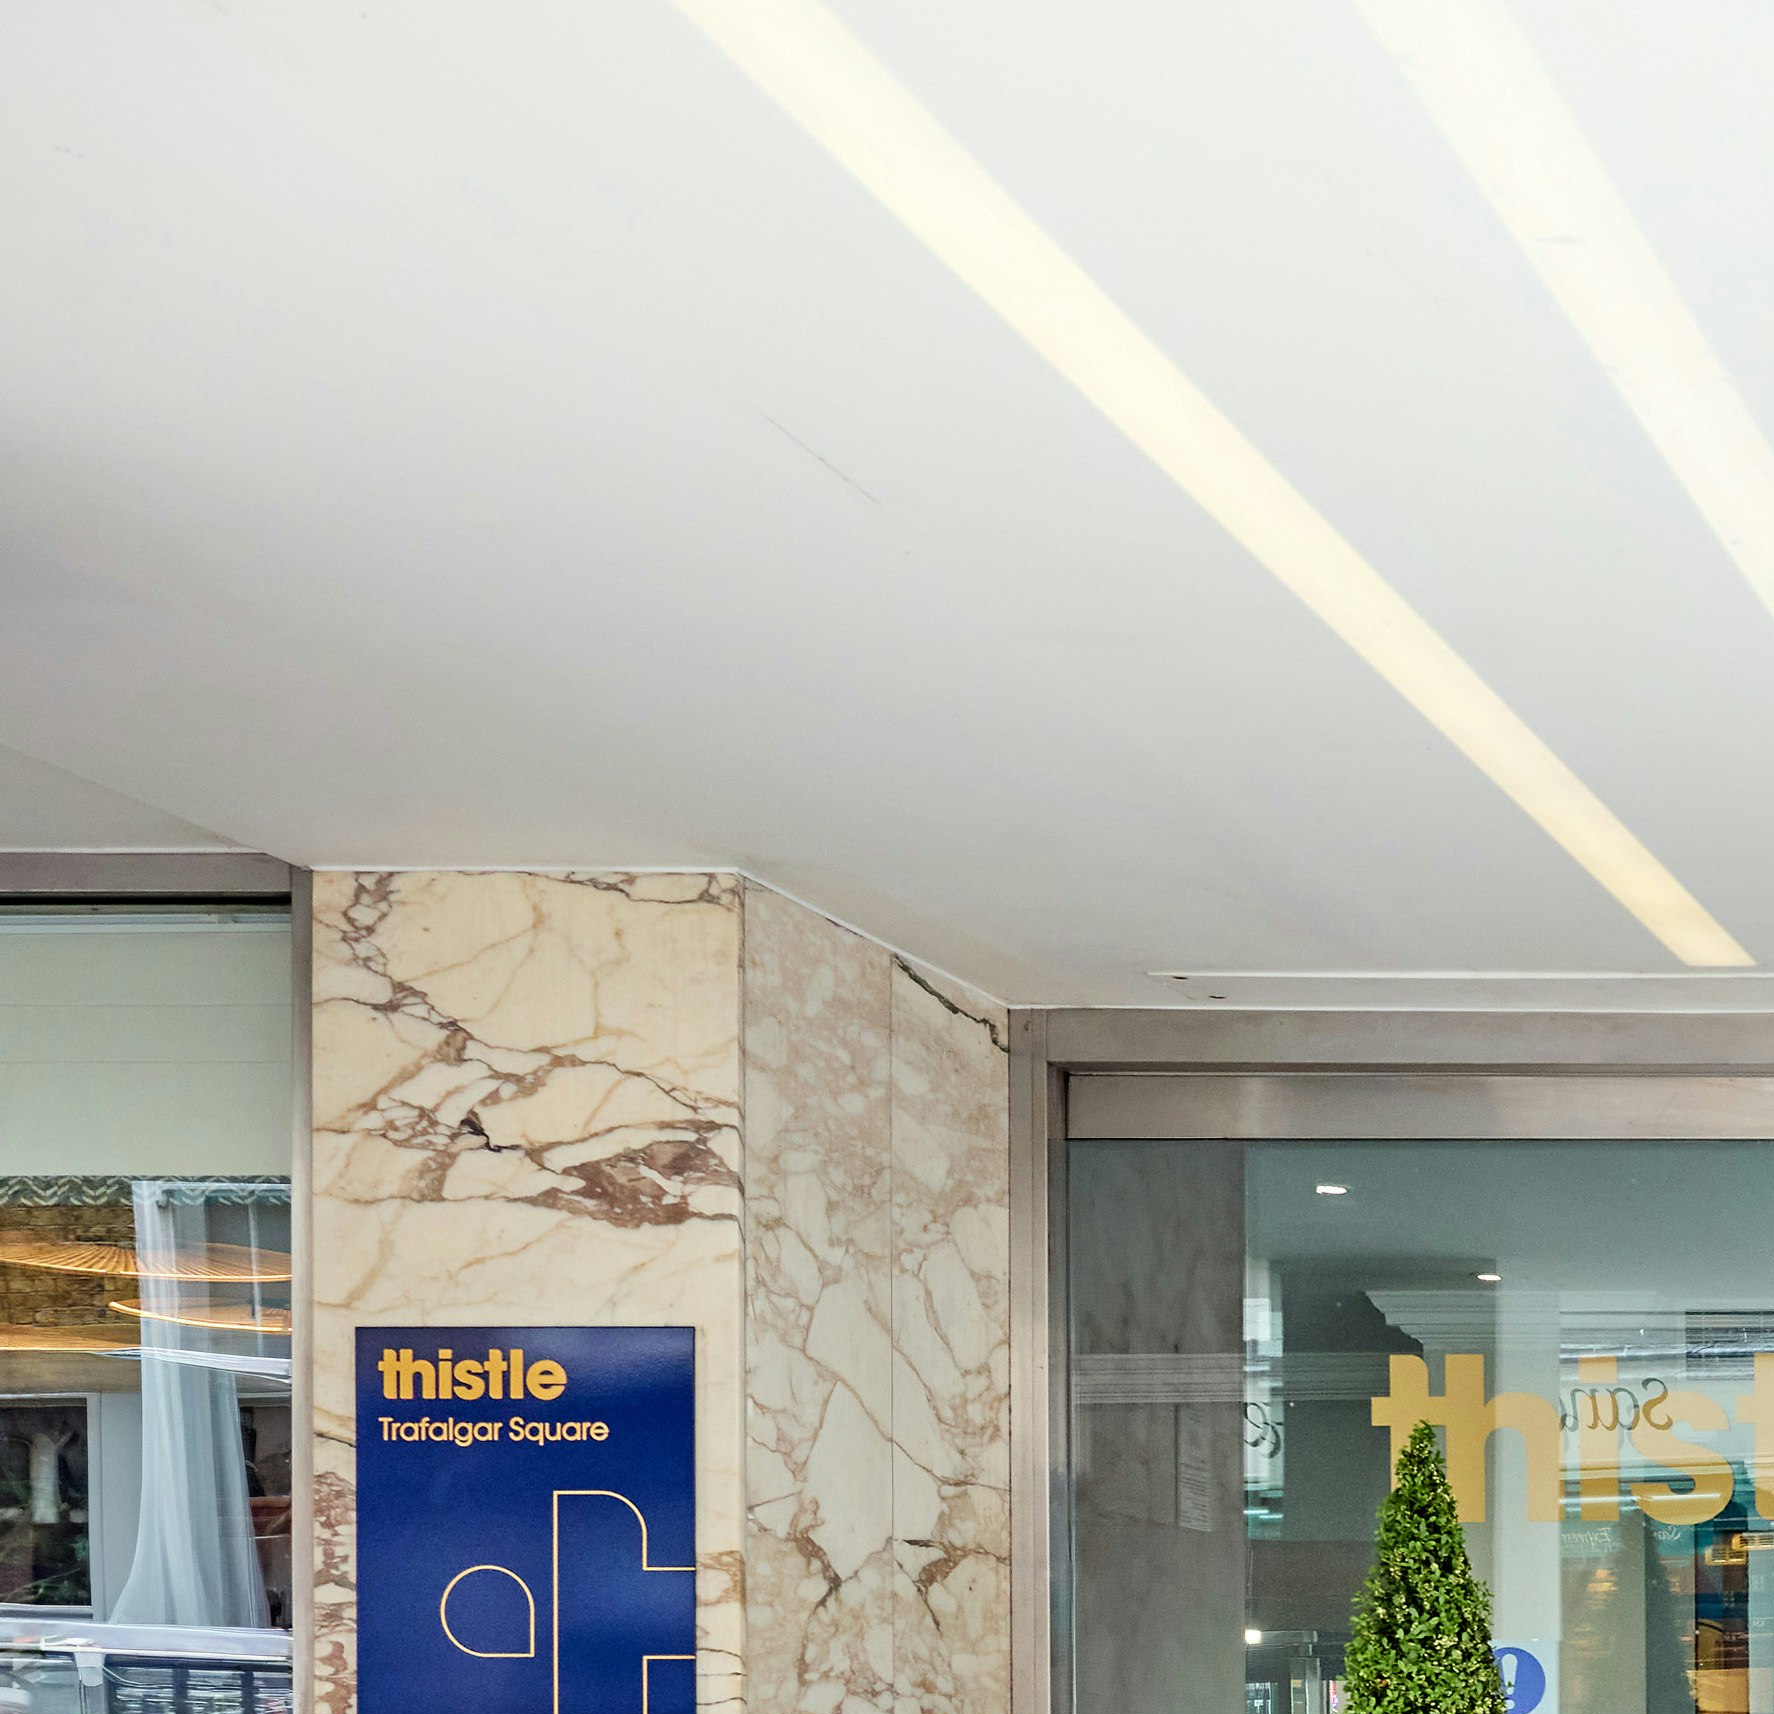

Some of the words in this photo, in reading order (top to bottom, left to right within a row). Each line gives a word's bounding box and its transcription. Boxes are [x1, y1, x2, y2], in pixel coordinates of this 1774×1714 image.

[378, 1347, 567, 1401] thistle
[379, 1416, 503, 1447] Trafalgar
[508, 1416, 609, 1447] Square
